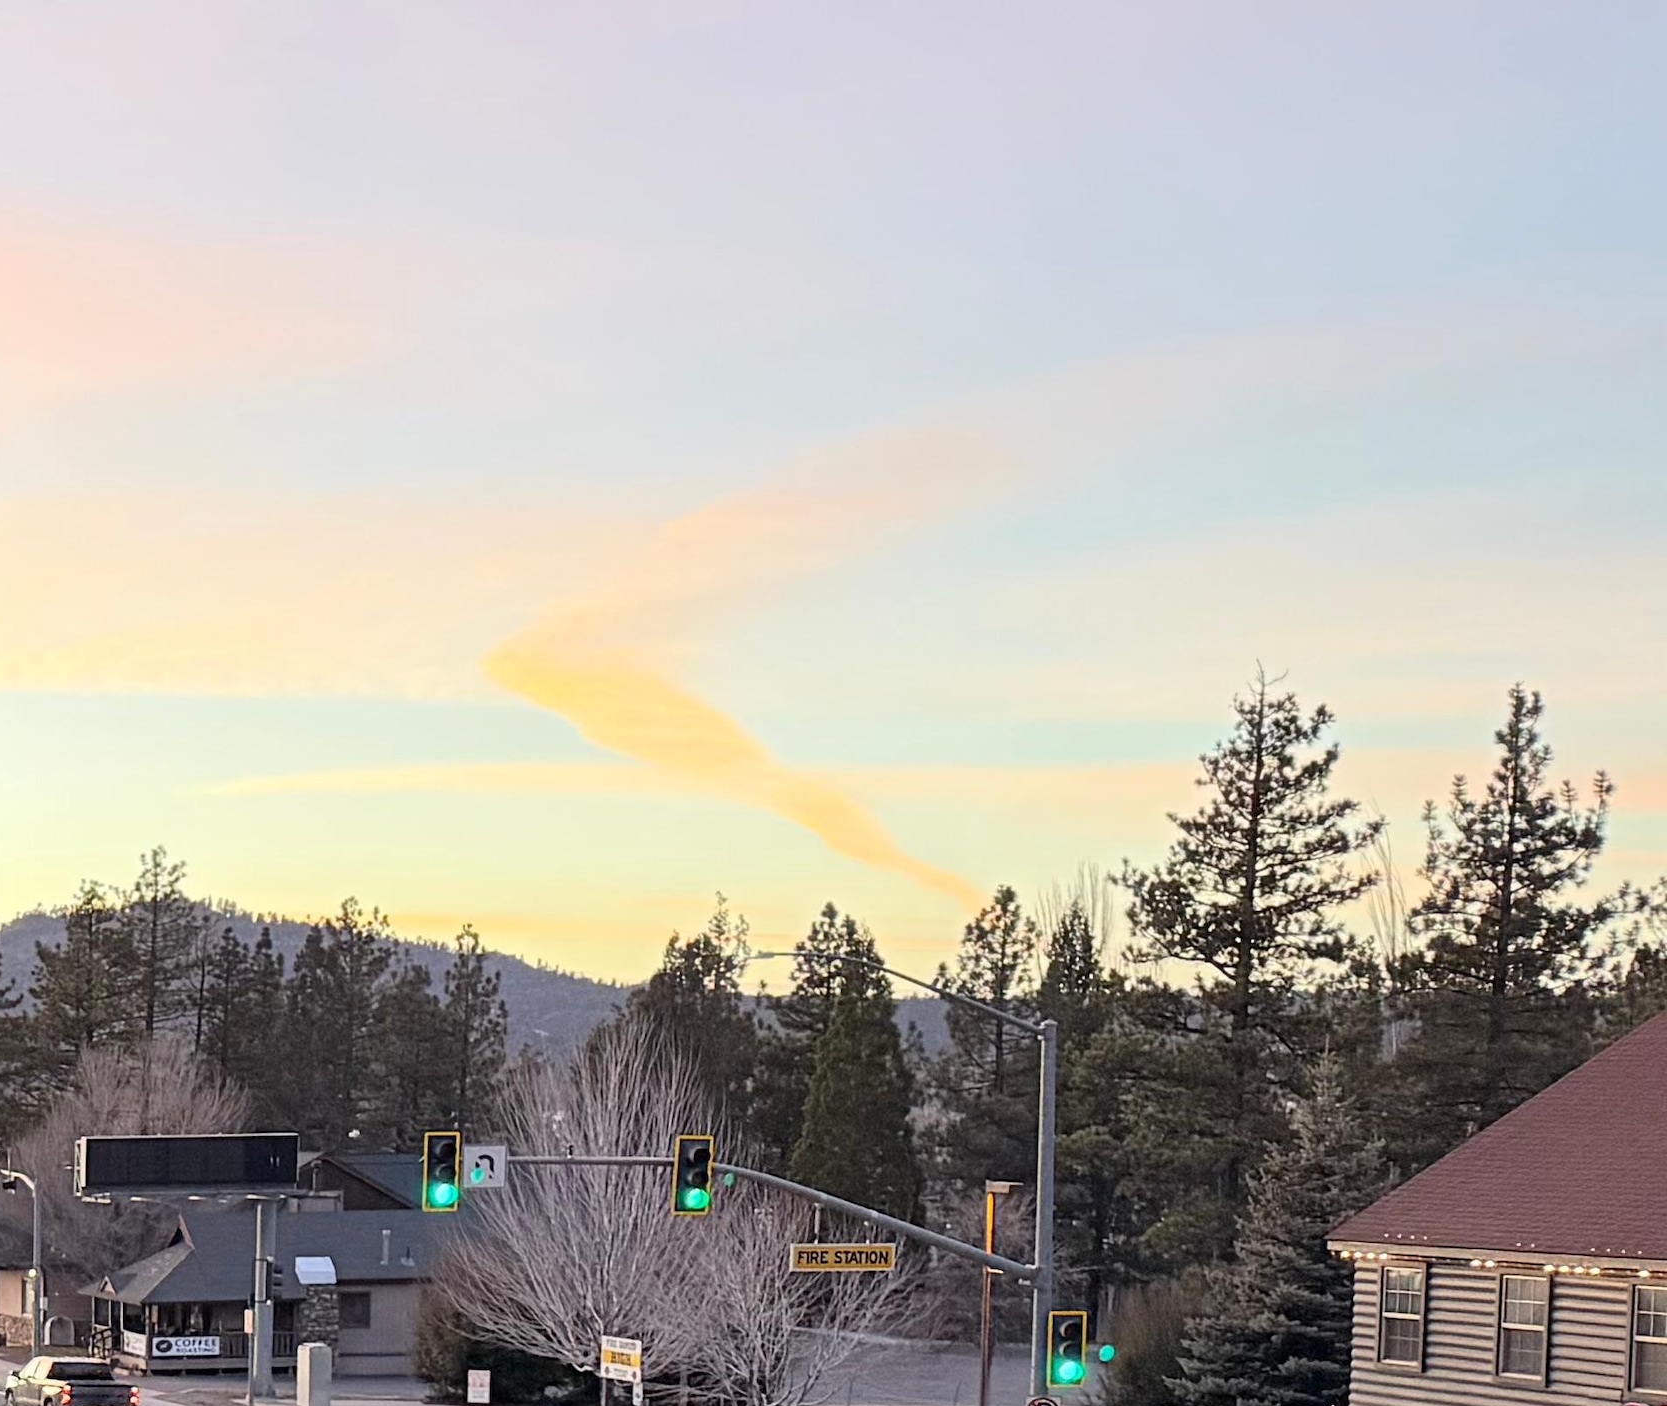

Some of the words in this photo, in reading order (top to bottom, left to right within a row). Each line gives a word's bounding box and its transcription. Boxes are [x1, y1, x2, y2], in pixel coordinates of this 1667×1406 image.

[798, 1250, 828, 1264] FIRE
[834, 1250, 889, 1264] STATION
[175, 1338, 217, 1347] COFFEE
